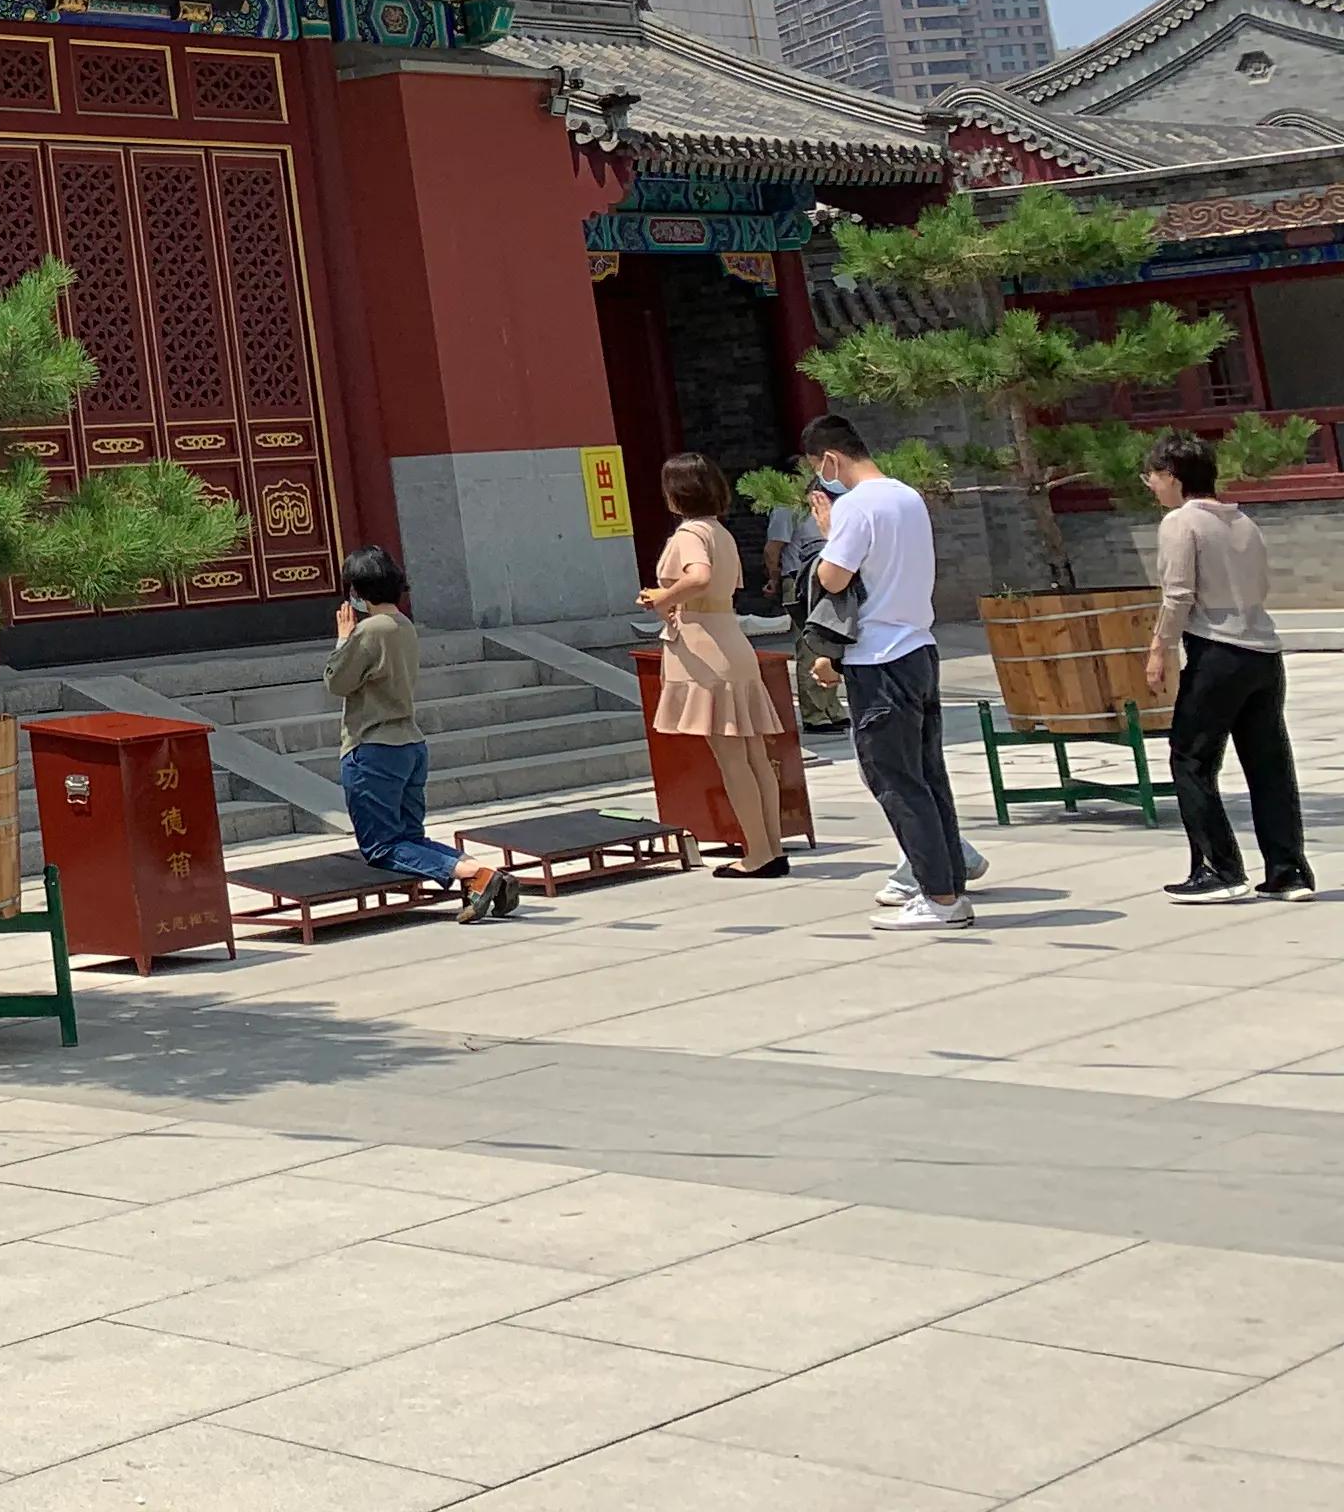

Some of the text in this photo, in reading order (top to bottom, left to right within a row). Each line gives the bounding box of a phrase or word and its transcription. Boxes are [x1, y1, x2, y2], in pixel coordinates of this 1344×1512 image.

[595, 459, 617, 521] 出口
[155, 762, 193, 879] 功德箱
